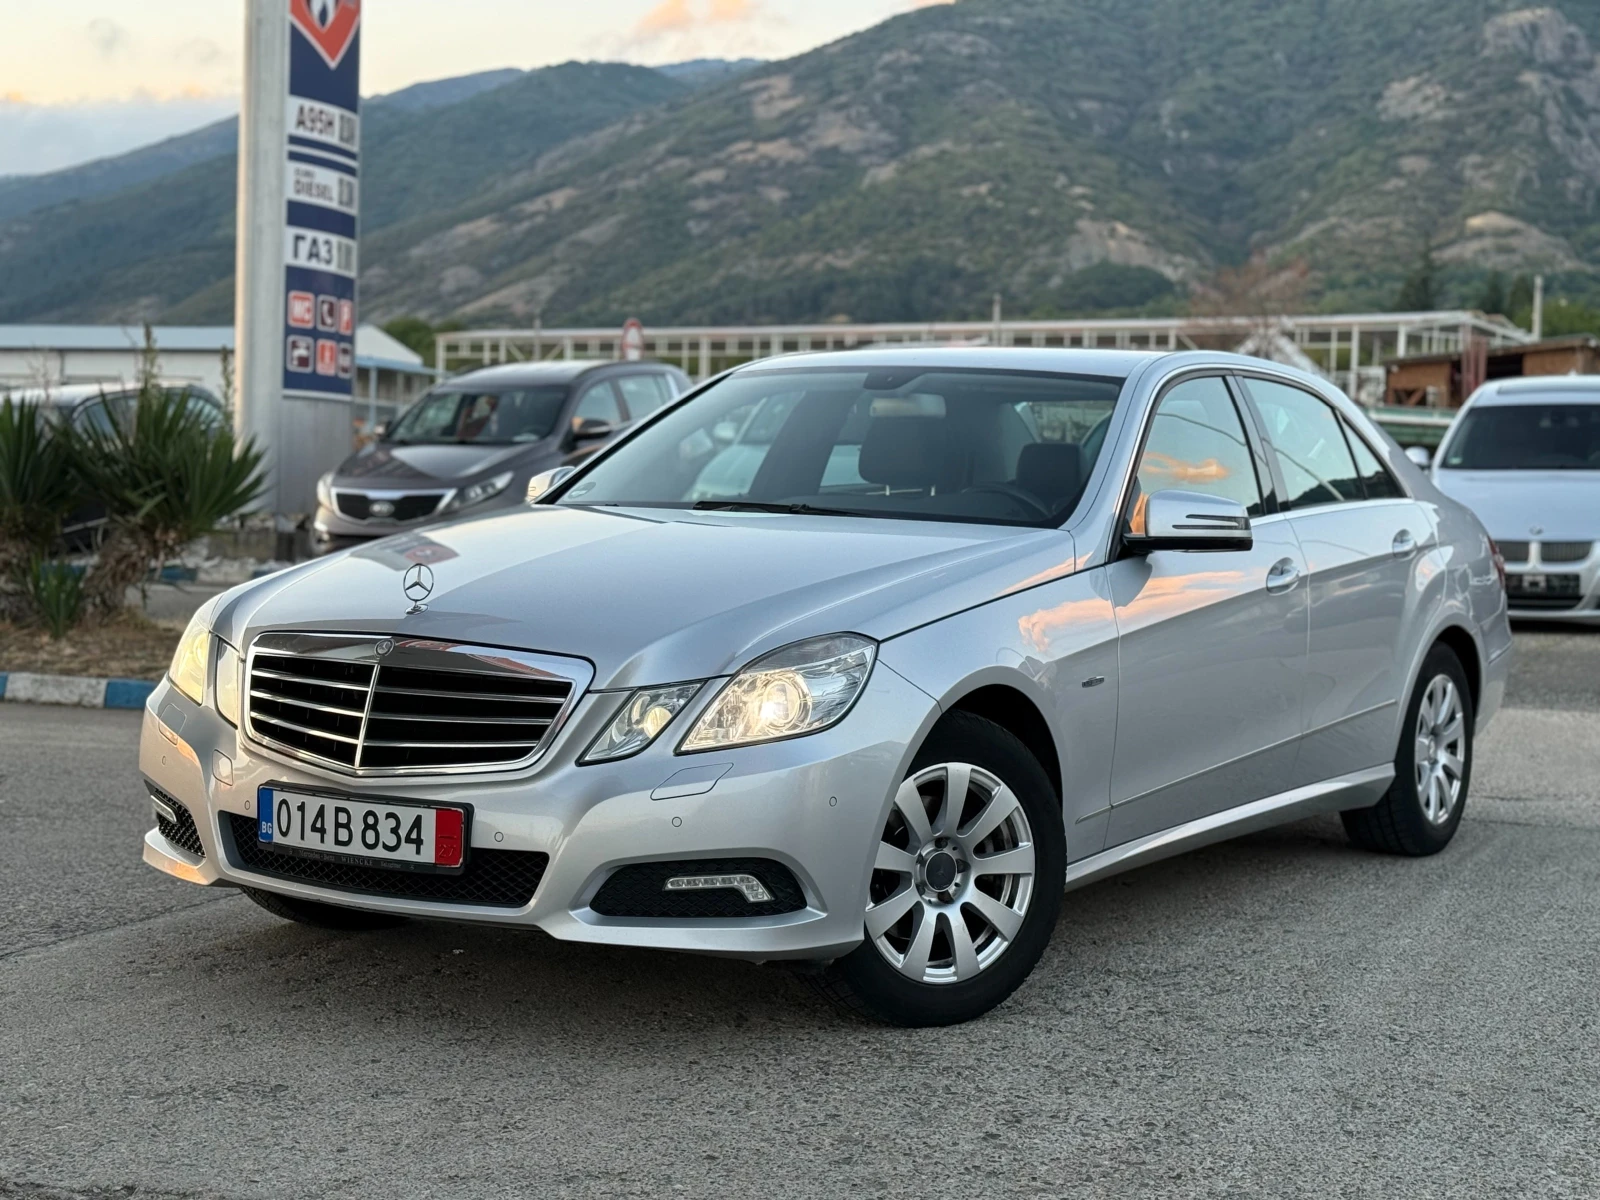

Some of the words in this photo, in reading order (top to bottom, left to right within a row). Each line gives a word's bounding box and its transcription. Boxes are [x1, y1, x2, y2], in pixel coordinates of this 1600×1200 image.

[294, 179, 333, 202] DIESEL
[293, 233, 333, 265] ГАЗ
[261, 821, 272, 834] BG
[341, 856, 374, 867] WIENCKE
